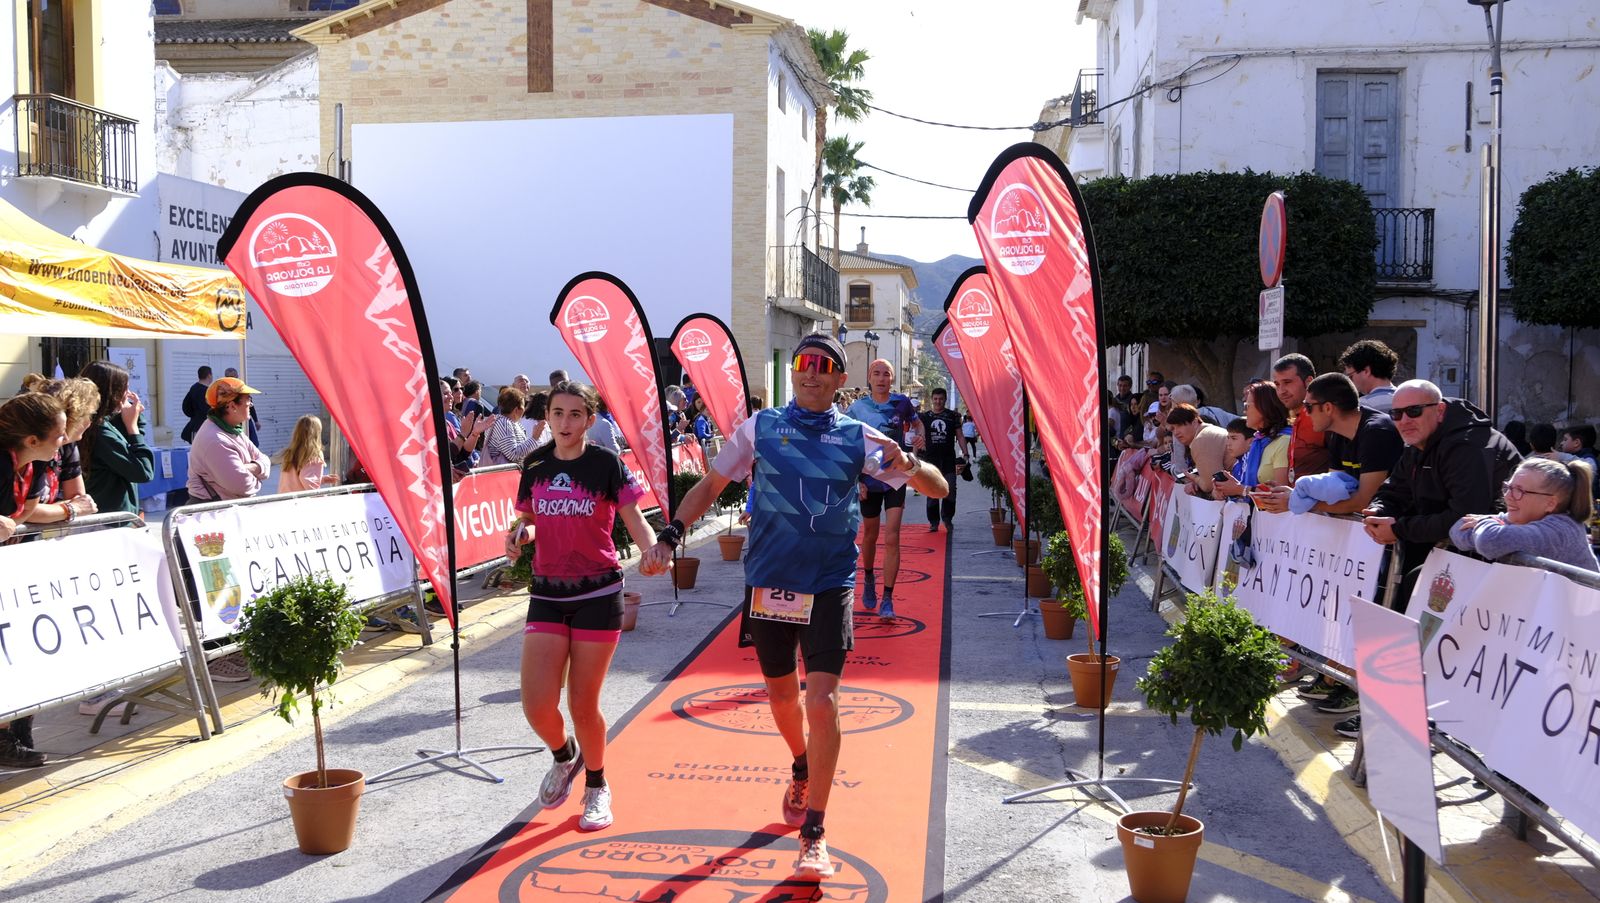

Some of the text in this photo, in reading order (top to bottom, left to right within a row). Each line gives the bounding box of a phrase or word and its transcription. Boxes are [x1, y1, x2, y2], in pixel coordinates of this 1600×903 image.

[171, 239, 225, 265] AYUNTA
[453, 497, 518, 541] VEOLIA
[537, 498, 596, 517] BUSCACIMAS
[244, 516, 393, 552] AYUNTAMIENTO DE
[112, 564, 141, 587] DE
[248, 535, 403, 594] CANTORIA
[1343, 558, 1366, 581] DE
[769, 587, 796, 602] 26
[579, 848, 777, 870] POLVORA
[607, 841, 707, 854] Cantoria
